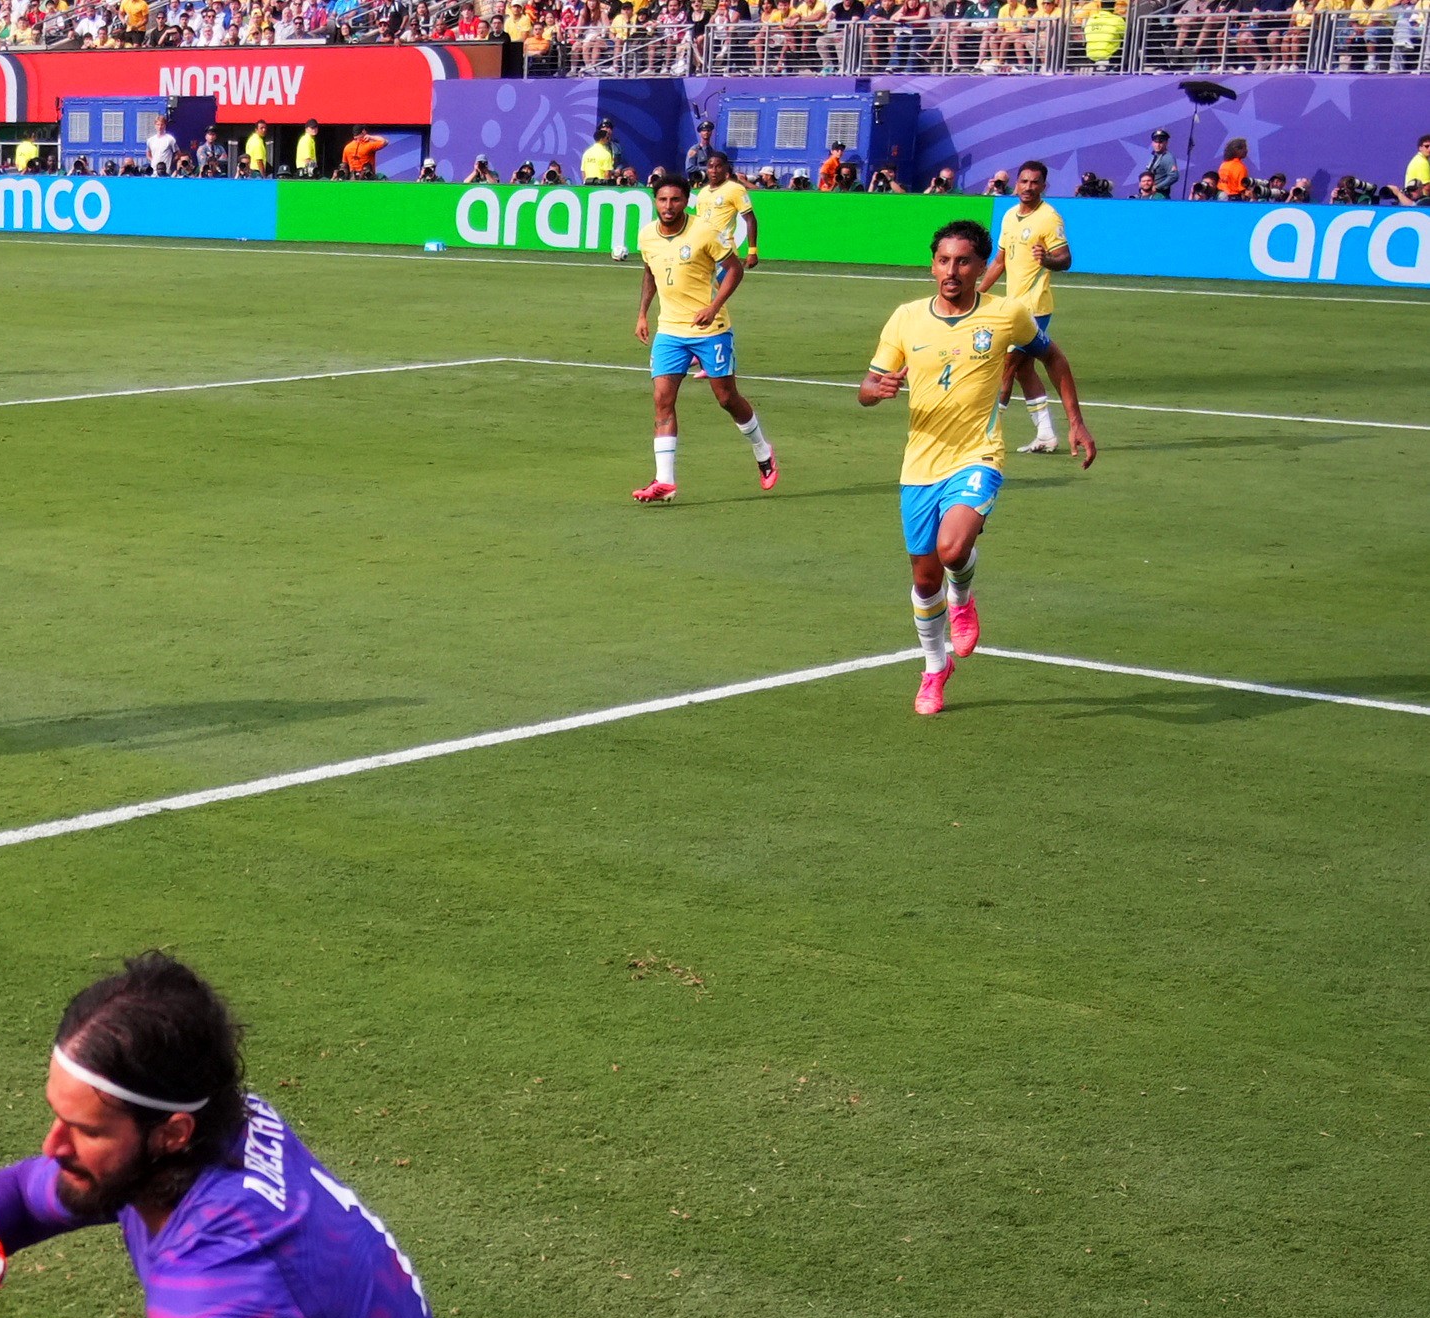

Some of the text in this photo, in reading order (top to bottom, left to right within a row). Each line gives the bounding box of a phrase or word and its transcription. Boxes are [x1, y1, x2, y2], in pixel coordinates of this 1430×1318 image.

[159, 66, 304, 106] NORWAY
[455, 187, 748, 252] aram
[714, 343, 725, 363] 2
[938, 364, 951, 391] 4
[967, 471, 982, 491] 4
